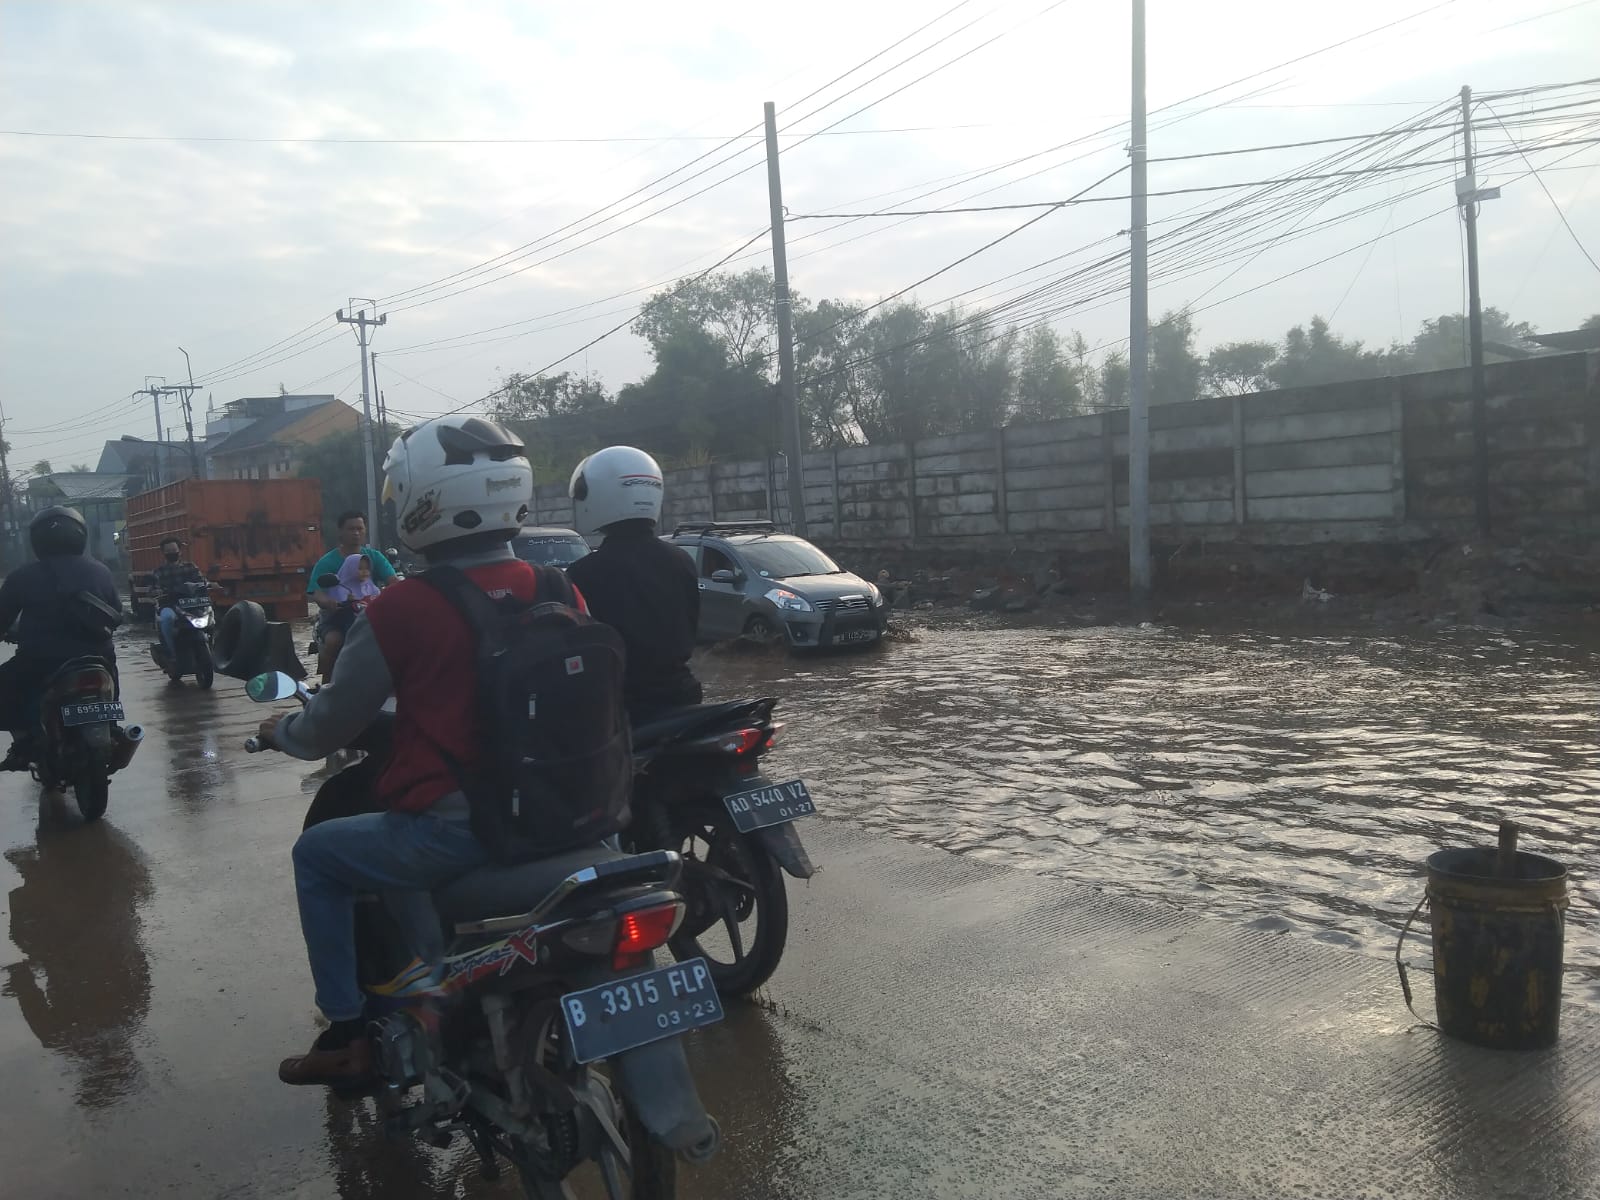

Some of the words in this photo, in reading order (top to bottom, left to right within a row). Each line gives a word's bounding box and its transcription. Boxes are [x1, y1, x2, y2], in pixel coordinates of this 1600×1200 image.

[64, 707, 70, 716] B
[77, 704, 100, 714] 6955
[731, 797, 749, 814] AD
[751, 788, 784, 807] 5440
[786, 782, 806, 799] VZ
[568, 999, 586, 1027] B
[601, 978, 660, 1015] 3315
[668, 965, 706, 997] FLP
